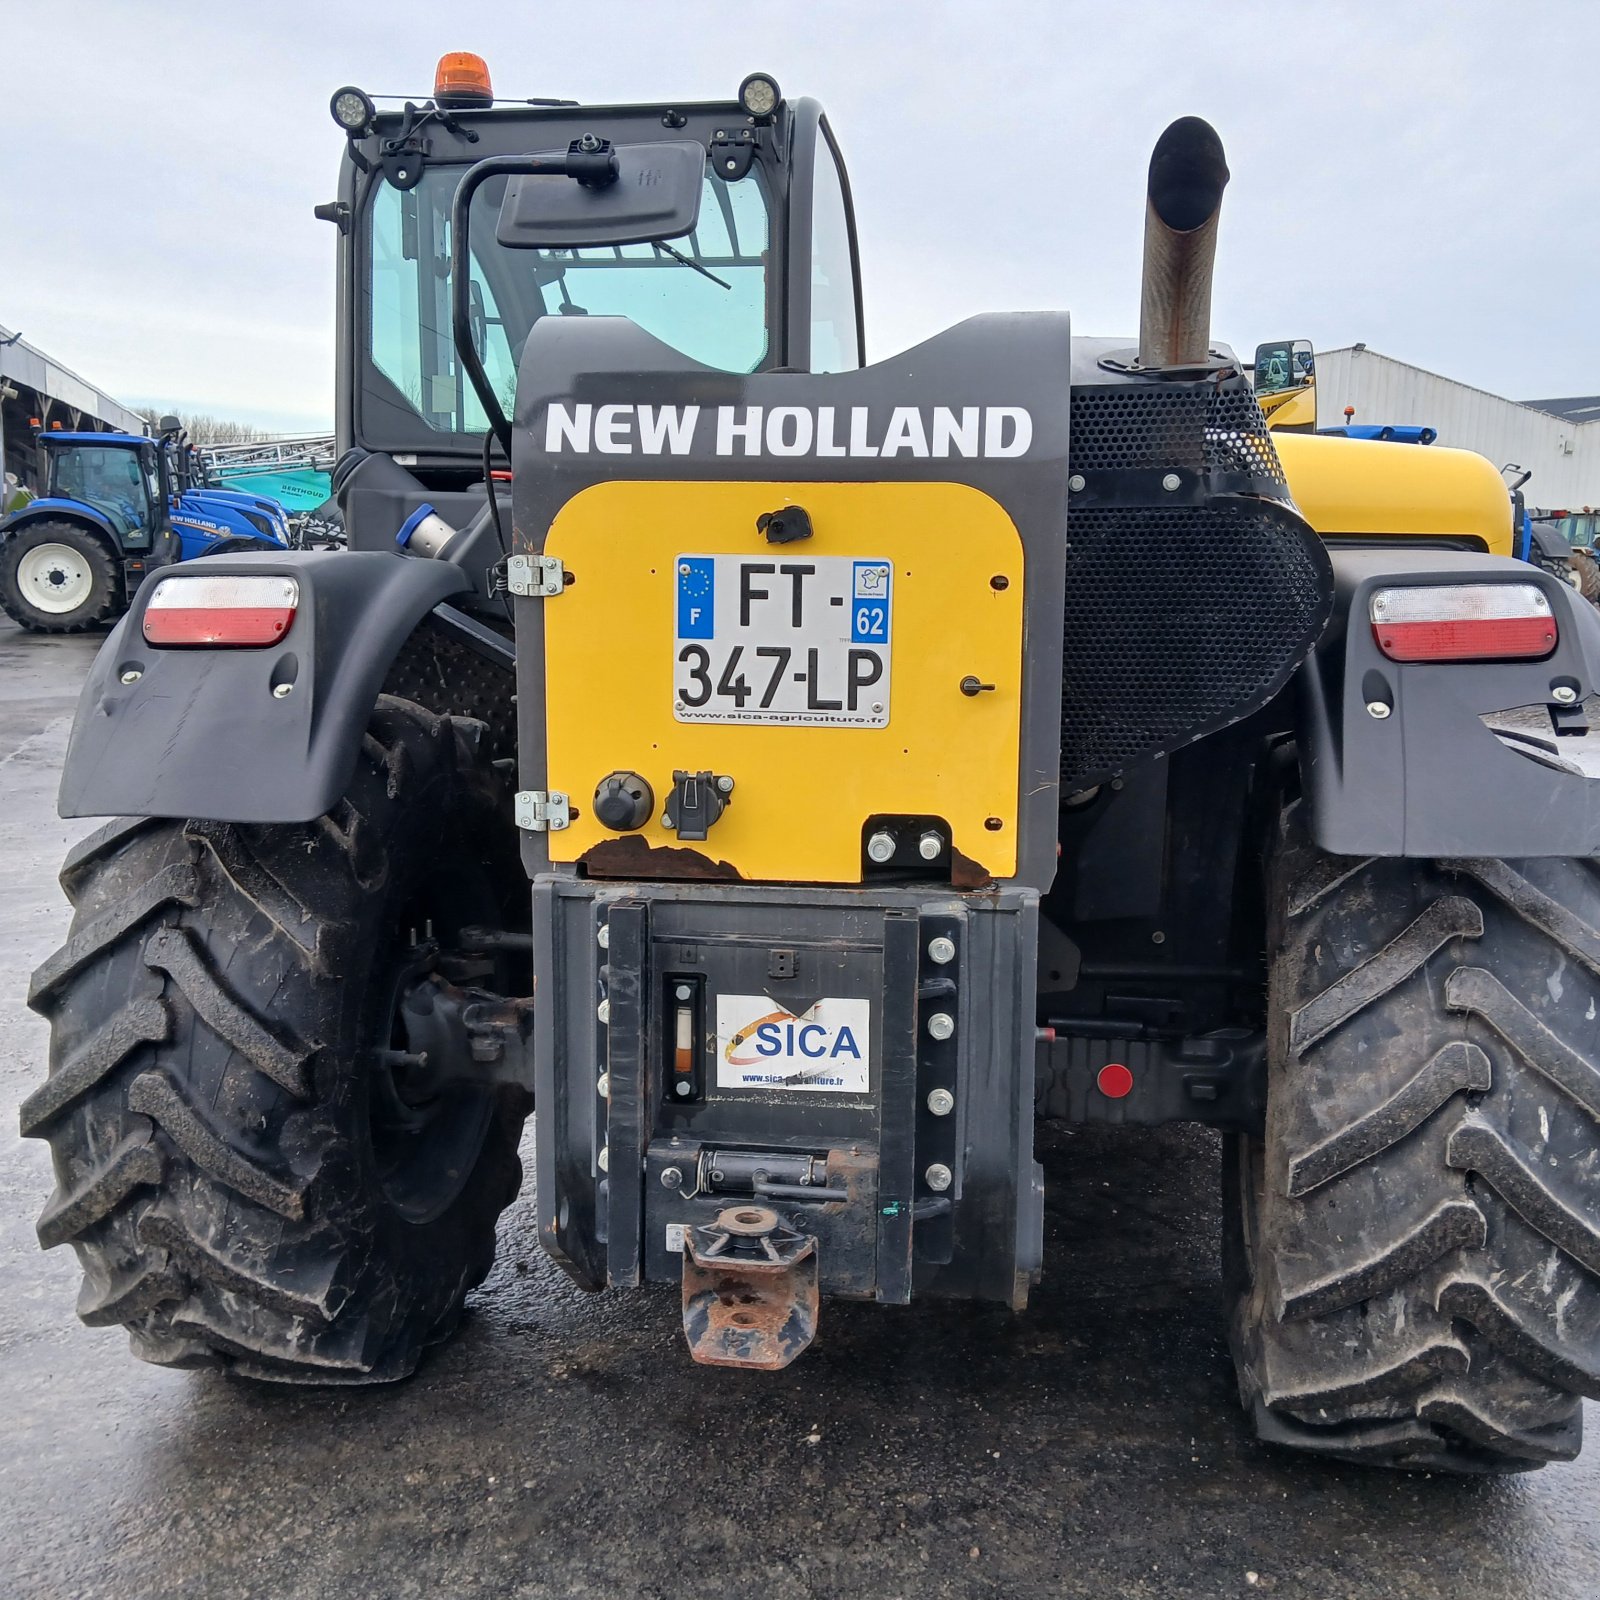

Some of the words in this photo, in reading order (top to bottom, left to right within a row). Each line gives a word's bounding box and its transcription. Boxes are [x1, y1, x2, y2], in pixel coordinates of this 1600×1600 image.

[545, 403, 701, 456] NEW
[716, 405, 1034, 458] HOLLAND
[281, 484, 324, 499] BERTHOUD
[184, 516, 217, 529] HOLLAND
[690, 608, 701, 625] F
[856, 607, 884, 635] 62
[678, 643, 883, 711] 347-LP
[679, 712, 885, 724] www.sica-agriculture.fr
[755, 1022, 861, 1059] SICA
